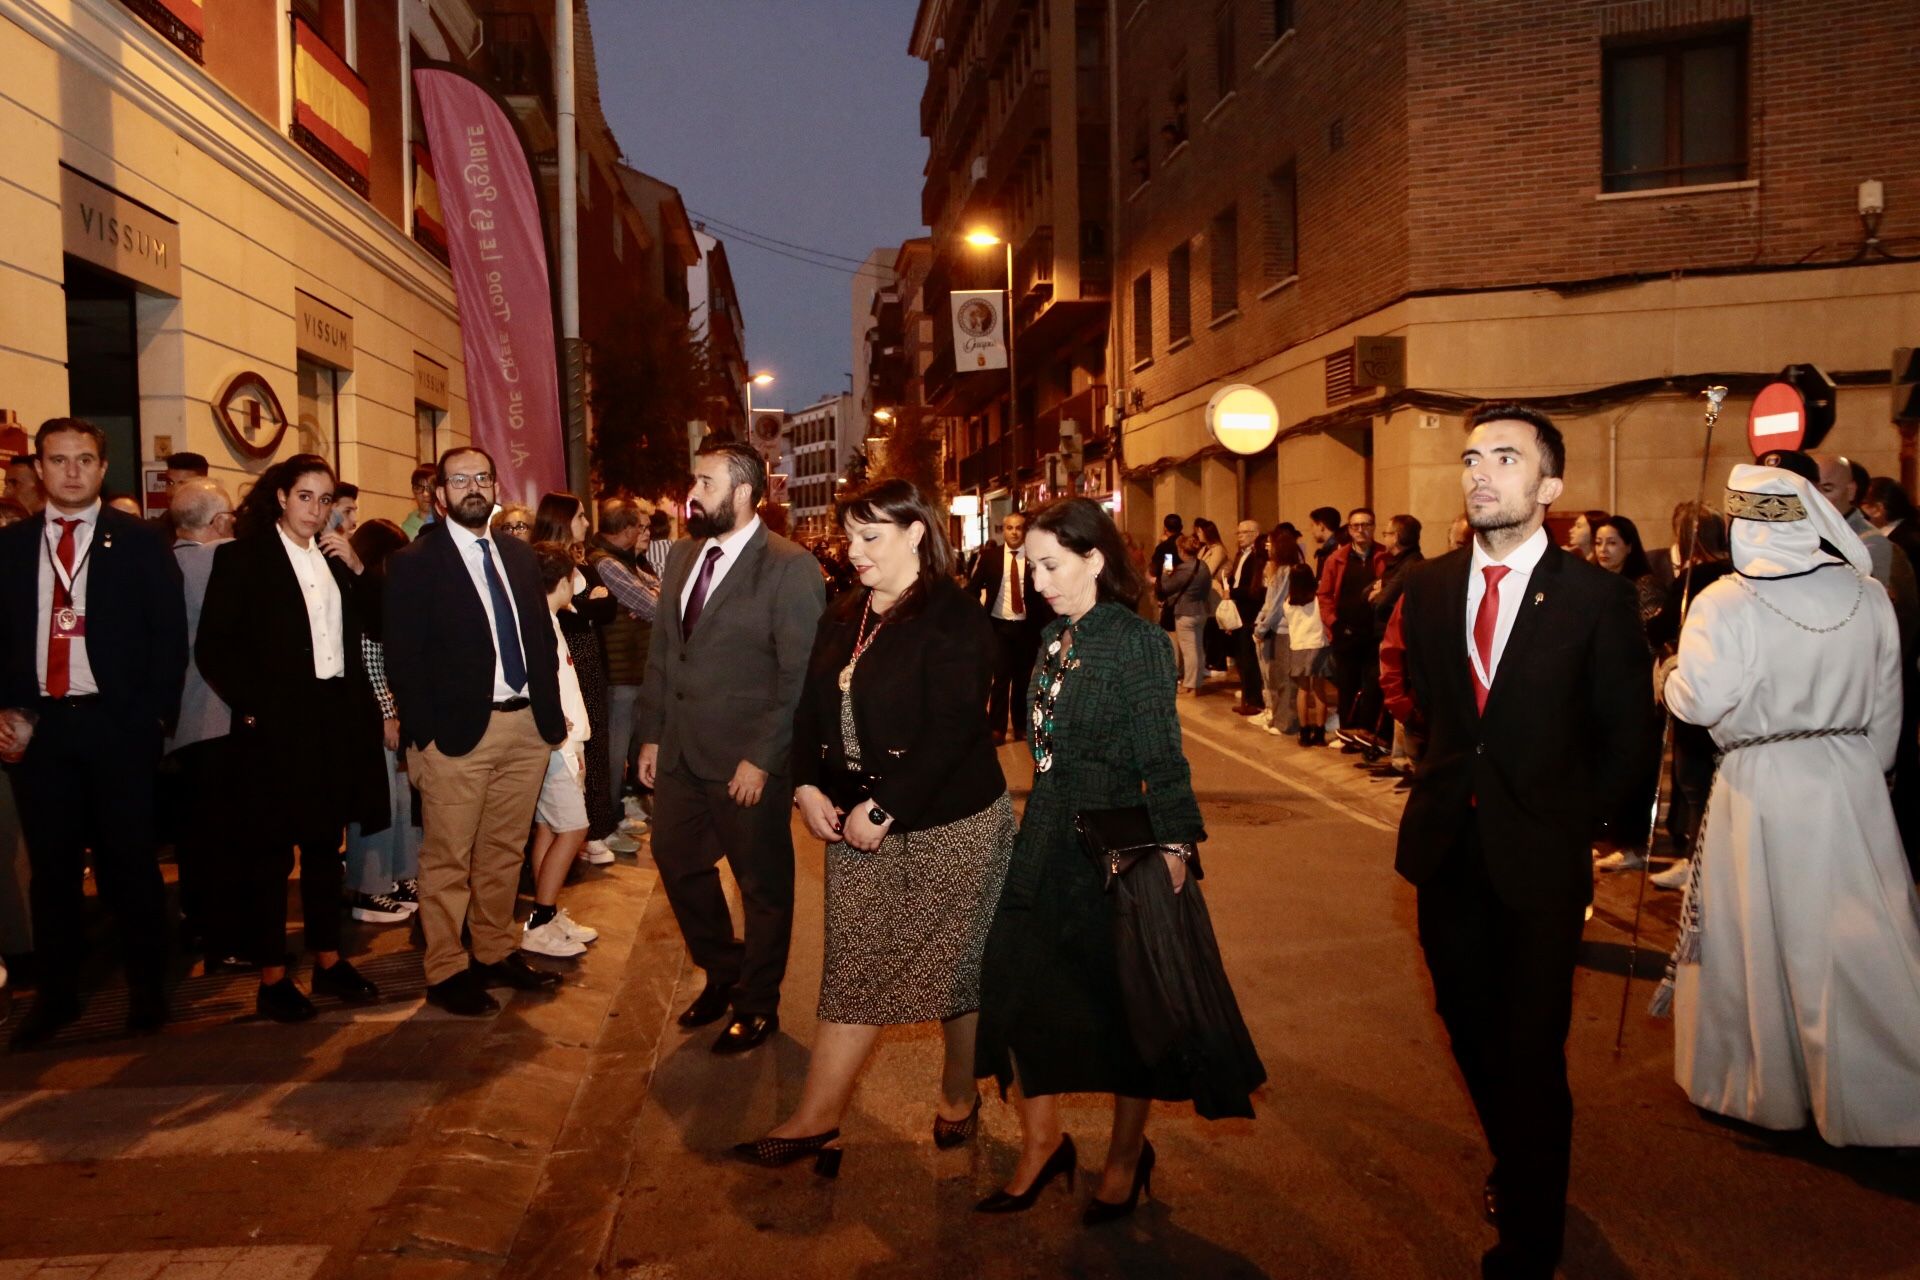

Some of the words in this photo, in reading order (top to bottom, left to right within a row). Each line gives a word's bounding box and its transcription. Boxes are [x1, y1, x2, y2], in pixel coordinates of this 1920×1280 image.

[79, 202, 168, 270] VISSUM
[303, 312, 348, 351] VISSUM
[418, 370, 446, 394] VISSUM
